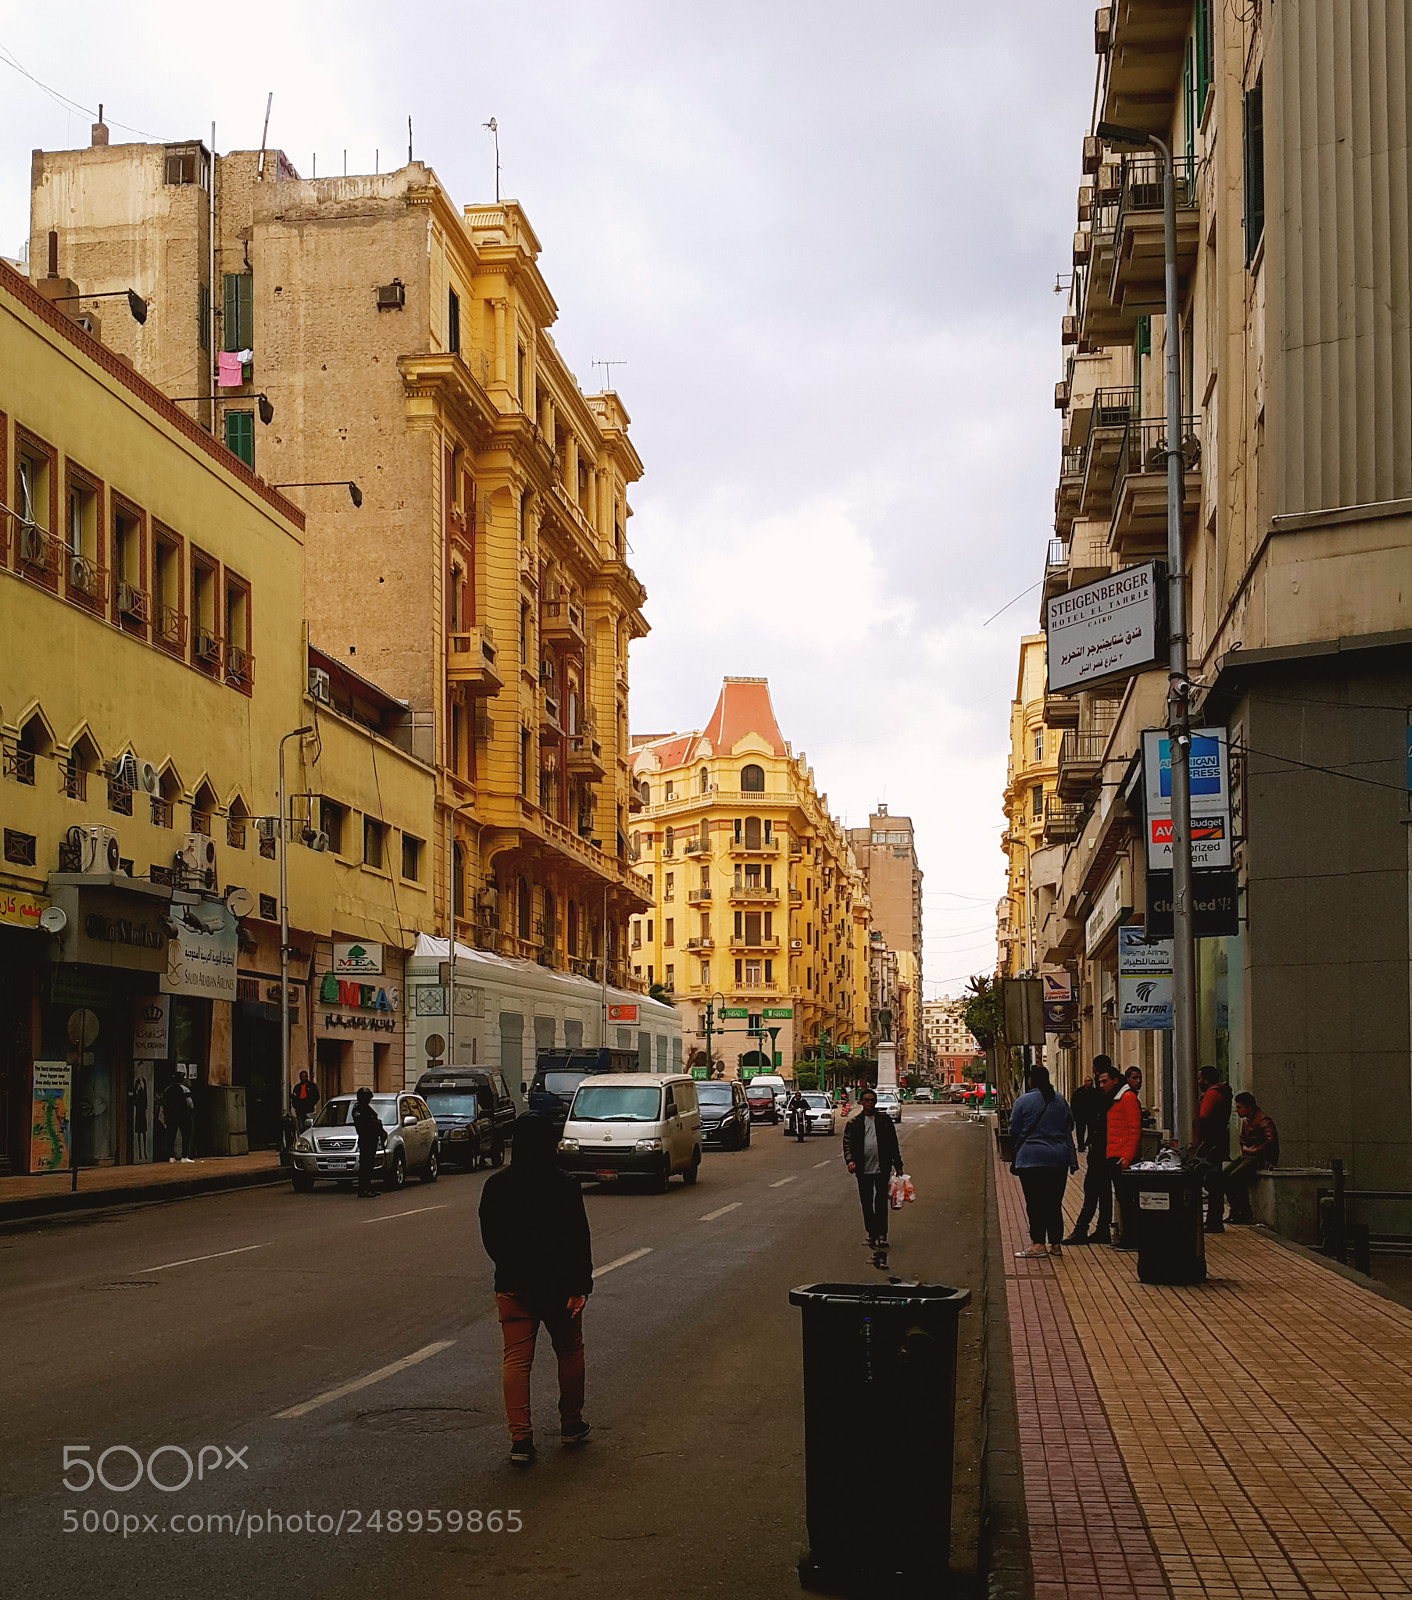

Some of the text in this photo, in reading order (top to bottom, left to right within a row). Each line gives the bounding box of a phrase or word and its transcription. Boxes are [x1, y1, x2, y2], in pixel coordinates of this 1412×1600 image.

[1051, 572, 1148, 618] STEIGENBERGER
[1052, 589, 1149, 629] HOTEL EL TAHRIR
[1087, 615, 1112, 628] CAIRO
[1125, 626, 1142, 645] فندق
[1061, 646, 1085, 665] التحرير
[1104, 655, 1118, 668] شارع
[1079, 663, 1092, 676] النيل
[1092, 658, 1103, 671] قصر
[1190, 818, 1222, 830] Budget
[1153, 900, 1175, 912] Clu
[338, 958, 377, 967] MEA
[1123, 957, 1148, 967] للطيران
[337, 979, 391, 1011] MEA
